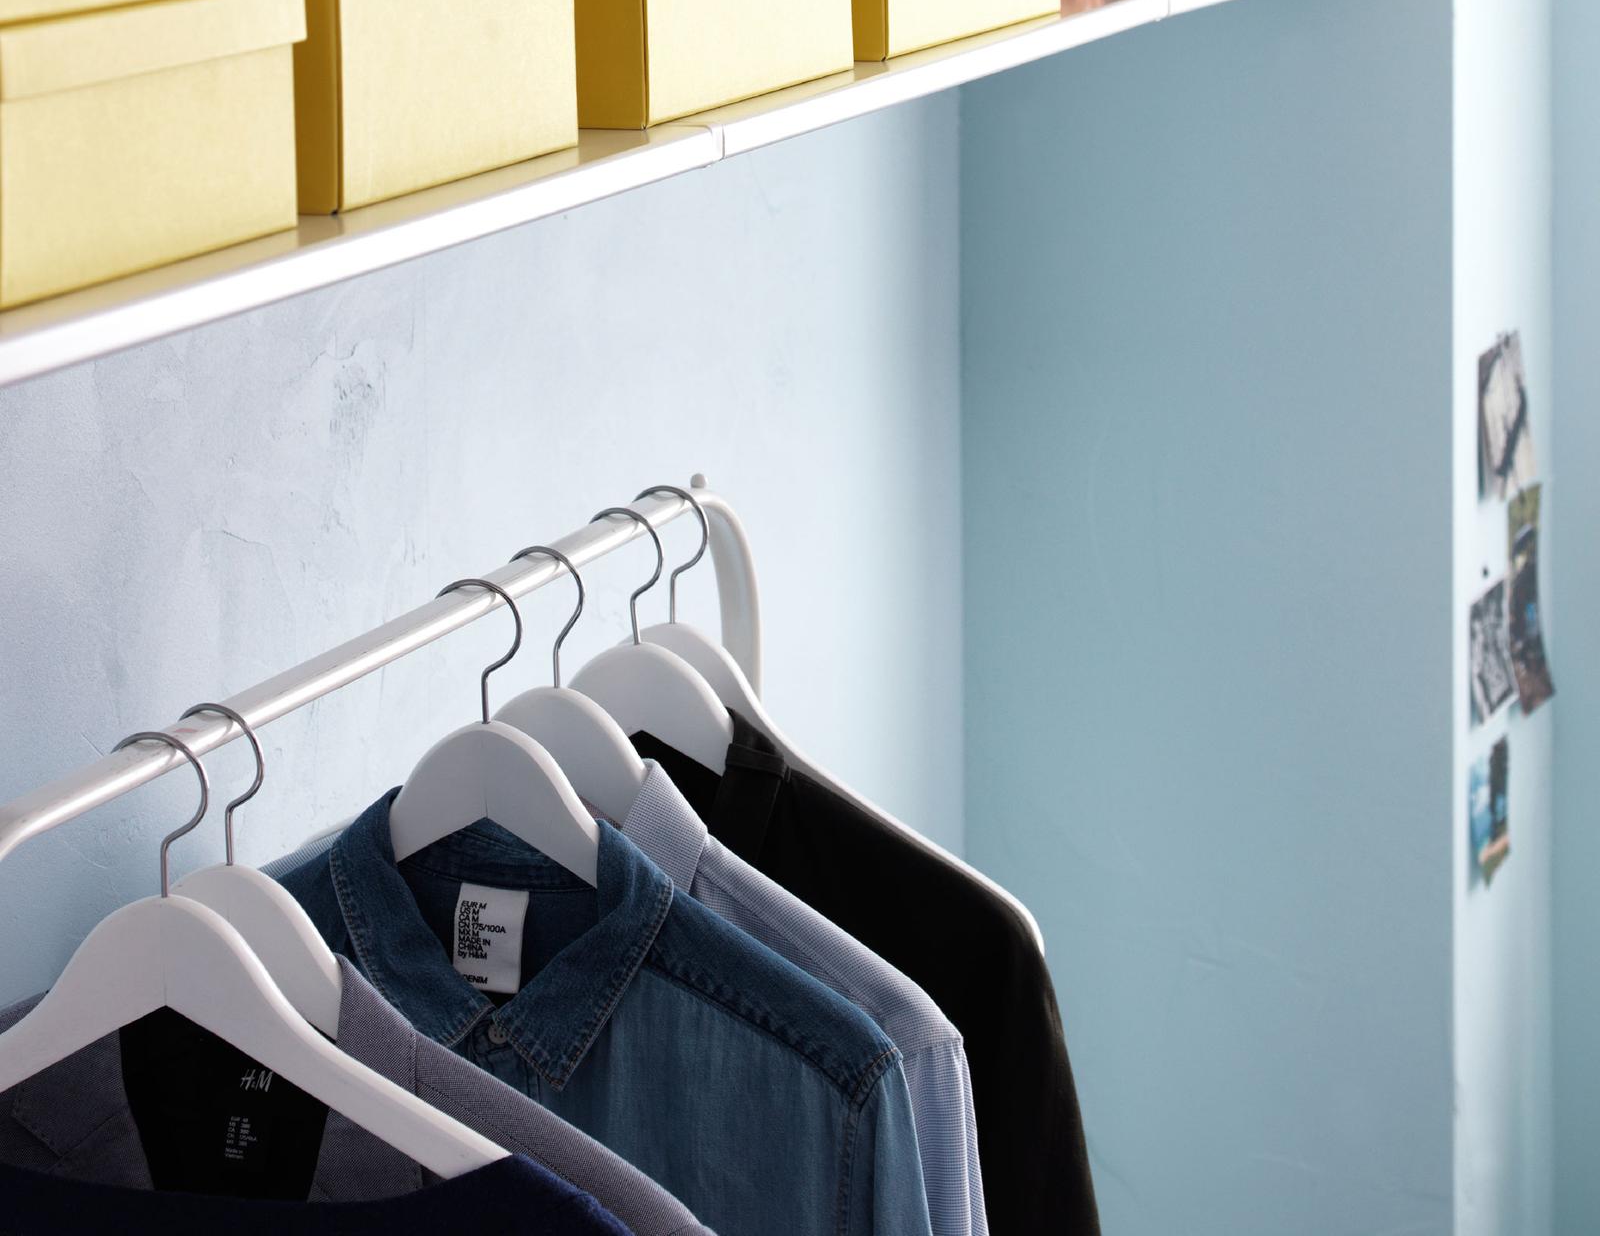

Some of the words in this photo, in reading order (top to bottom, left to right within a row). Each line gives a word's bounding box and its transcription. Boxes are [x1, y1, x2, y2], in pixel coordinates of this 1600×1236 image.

[461, 900, 478, 909] EUR
[479, 902, 487, 910] M
[460, 907, 471, 915] US
[459, 914, 470, 922] CA
[471, 915, 480, 923] M
[458, 921, 470, 929] CN
[471, 922, 506, 934] 175/100A
[458, 935, 481, 945] MADE
[482, 938, 491, 946] IN
[458, 942, 484, 952] CHINA
[457, 949, 467, 959] by
[468, 951, 488, 960] H&M
[240, 1068, 273, 1092] H&M
